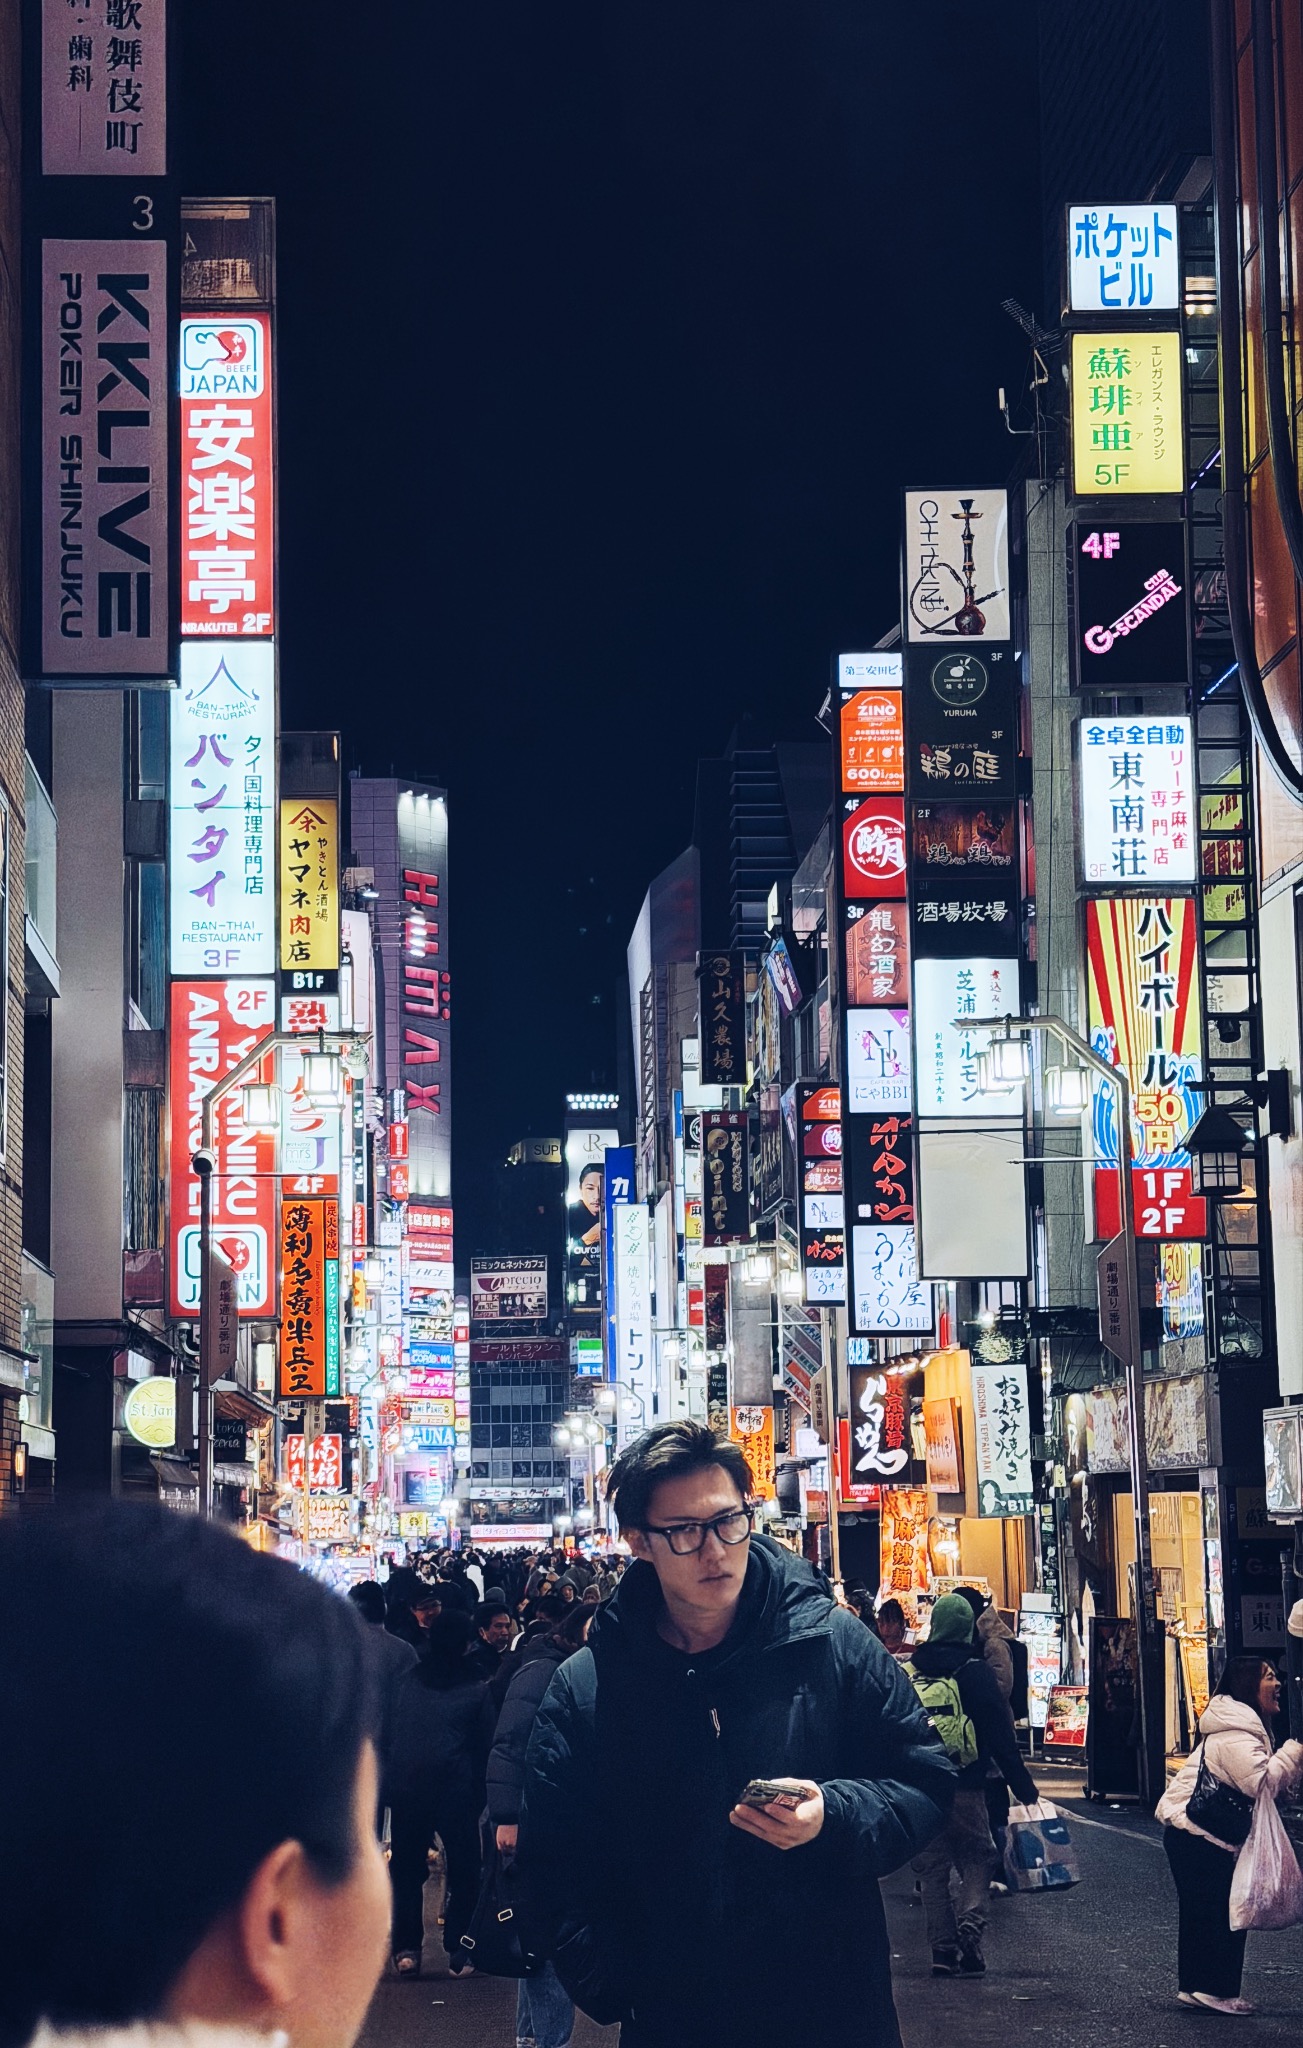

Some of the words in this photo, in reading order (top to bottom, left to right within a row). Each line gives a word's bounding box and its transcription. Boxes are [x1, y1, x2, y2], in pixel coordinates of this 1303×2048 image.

[104, 0, 143, 154] 歌舞伎町
[131, 195, 154, 231] 3
[1075, 211, 1173, 259] ポケット
[1100, 262, 1153, 308] ビル
[59, 272, 83, 417] POKER
[226, 364, 252, 373] BEEF
[184, 375, 258, 394] JAPAN
[1151, 345, 1166, 461] エレガンス・ラウンジ
[1094, 463, 1131, 486] 5F
[188, 403, 257, 614] 安楽亭
[59, 434, 84, 638] SHINJUKU
[1082, 532, 1120, 559] 4F
[1143, 568, 1170, 592] CLUB
[182, 622, 237, 633] NRAKUTEI
[242, 613, 271, 632] 2F
[1084, 580, 1183, 654] G-SCANDAL
[991, 652, 1003, 661] 3F
[188, 705, 258, 721] RESTAURANT
[196, 700, 249, 713] BAN-THAI
[857, 705, 897, 716] ZINO
[943, 709, 978, 717] YURUHA
[991, 730, 1004, 739] 3F
[1087, 725, 1185, 745] 全卓全自動
[845, 800, 860, 811] 4F
[1170, 750, 1189, 850] リーチ麻雀
[184, 733, 235, 908] バンタイ
[244, 735, 264, 895] タイ国料理専門店
[917, 809, 931, 818] 2F
[1108, 751, 1146, 877] 東南荘
[1150, 790, 1170, 865] 専門店
[315, 837, 329, 922] やきとん酒場
[1089, 863, 1108, 878] 3F
[286, 838, 312, 964] ヤマネ肉店
[847, 905, 864, 919] 3F
[917, 901, 1009, 923] 酒場牧場
[182, 931, 264, 943] RESTAURANT
[191, 920, 255, 931] BAN-THAI
[203, 949, 241, 968] 3F
[869, 909, 897, 999] 龍幻酒家
[292, 972, 324, 989] B1F
[237, 990, 268, 1011] 2F
[1137, 905, 1180, 1089] ハイボール
[711, 979, 734, 1070] 山久農場
[818, 1100, 841, 1109] ZIN
[710, 1113, 739, 1125] 麻雀
[534, 1143, 560, 1157] SUP
[293, 1175, 324, 1194] 4F
[611, 1176, 630, 1204] カ
[1142, 1171, 1184, 1199] 1F
[1141, 1207, 1186, 1234] 2F
[473, 1259, 545, 1270] コミック&ネットカフェ
[858, 1292, 872, 1329] 一番街
[1106, 1260, 1121, 1338] 劇場通り一番街
[218, 1279, 233, 1356] 劇場通り一番街
[904, 1316, 930, 1329] B1F
[976, 1375, 987, 1419] HIROSHIMA
[412, 1427, 455, 1445] AUNA
[992, 1374, 1029, 1482] お好み焼き
[1007, 1498, 1036, 1512] B1F
